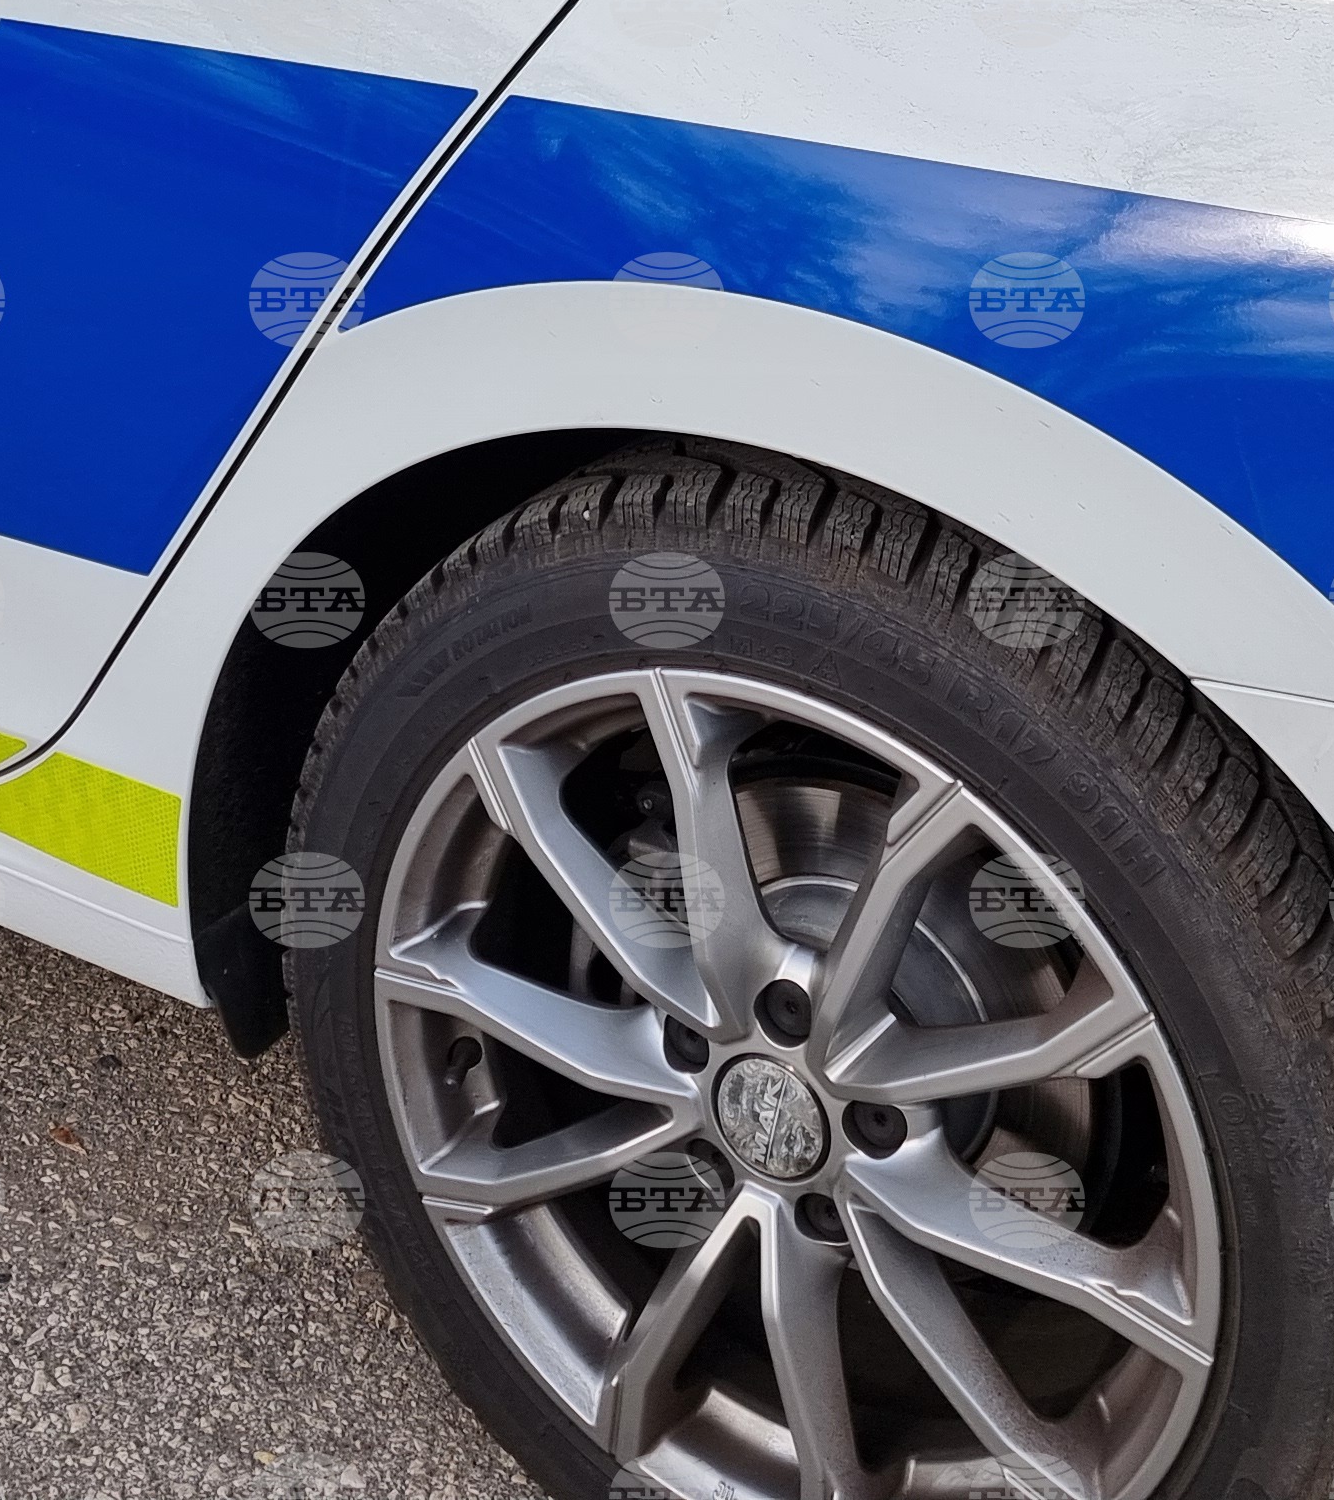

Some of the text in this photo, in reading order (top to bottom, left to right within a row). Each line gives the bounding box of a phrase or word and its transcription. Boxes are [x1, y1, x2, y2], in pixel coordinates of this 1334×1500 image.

[738, 583, 1166, 887] 225/45 R17 91H
[751, 1076, 784, 1165] MAK
